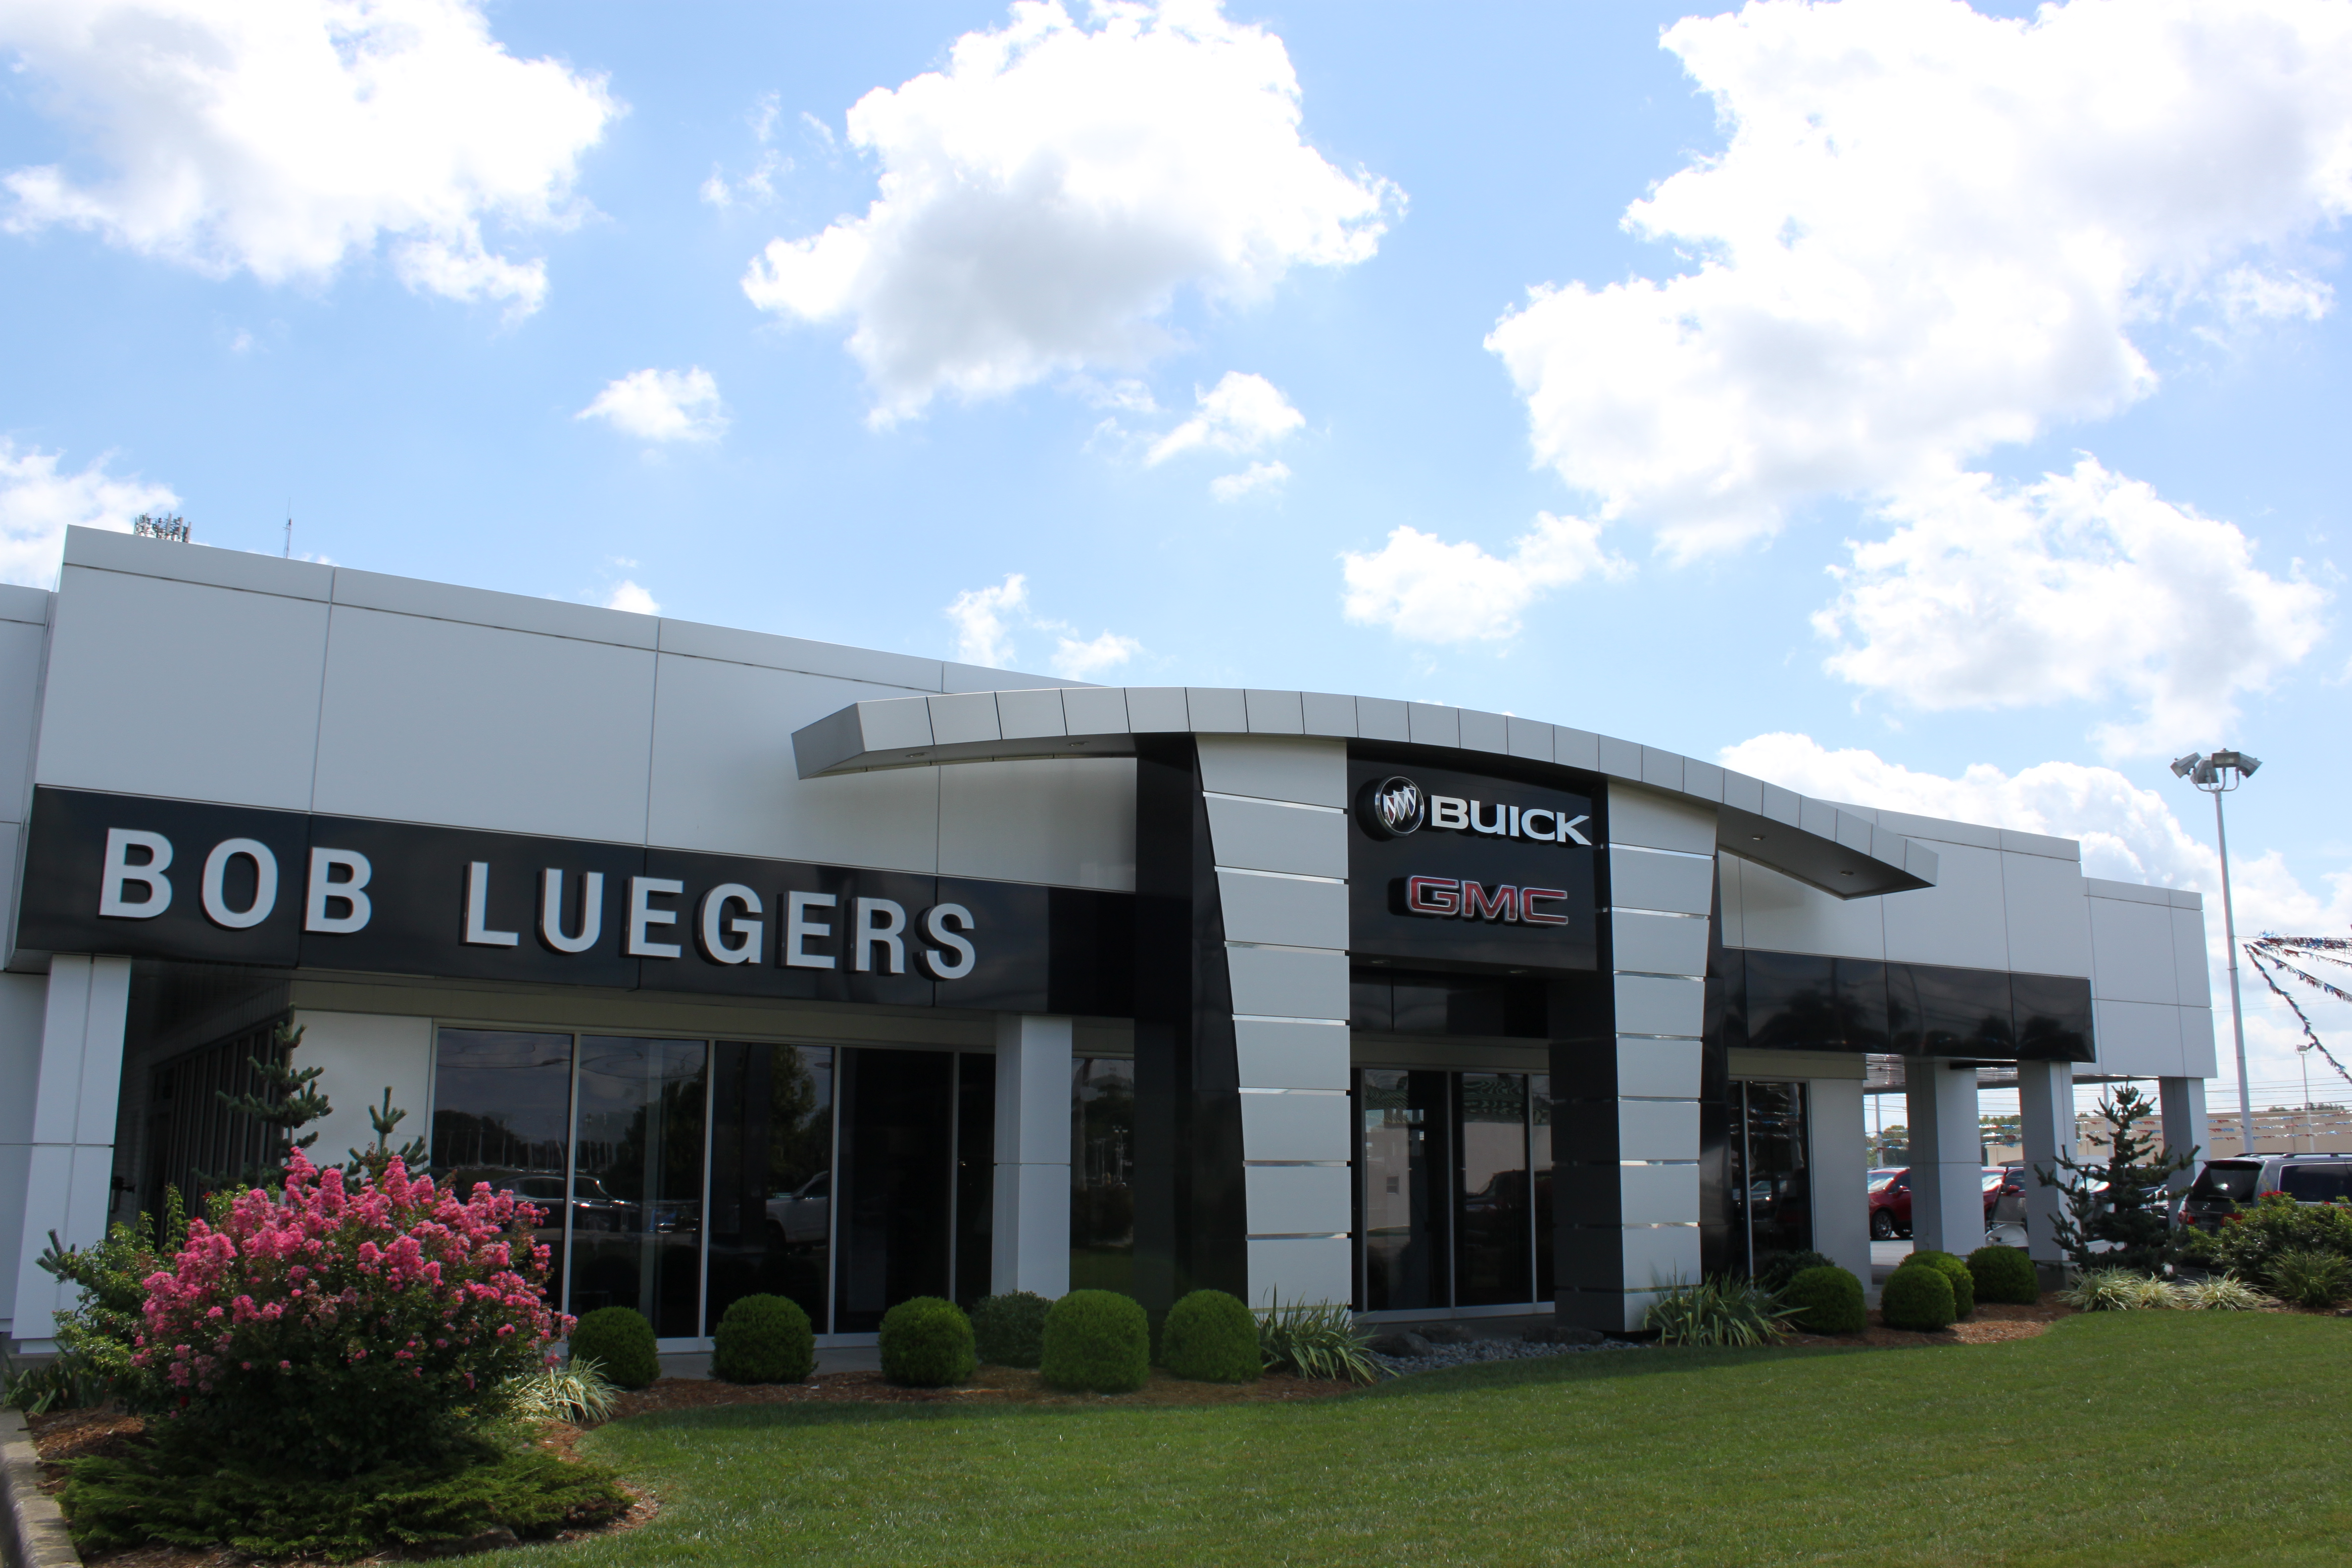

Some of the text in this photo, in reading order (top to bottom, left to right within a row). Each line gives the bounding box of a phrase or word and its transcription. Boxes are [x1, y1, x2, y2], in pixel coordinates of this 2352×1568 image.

[1431, 795, 1592, 845] BUICK
[99, 827, 975, 979] BOB LUEGERS
[1407, 875, 1568, 925] GMC
